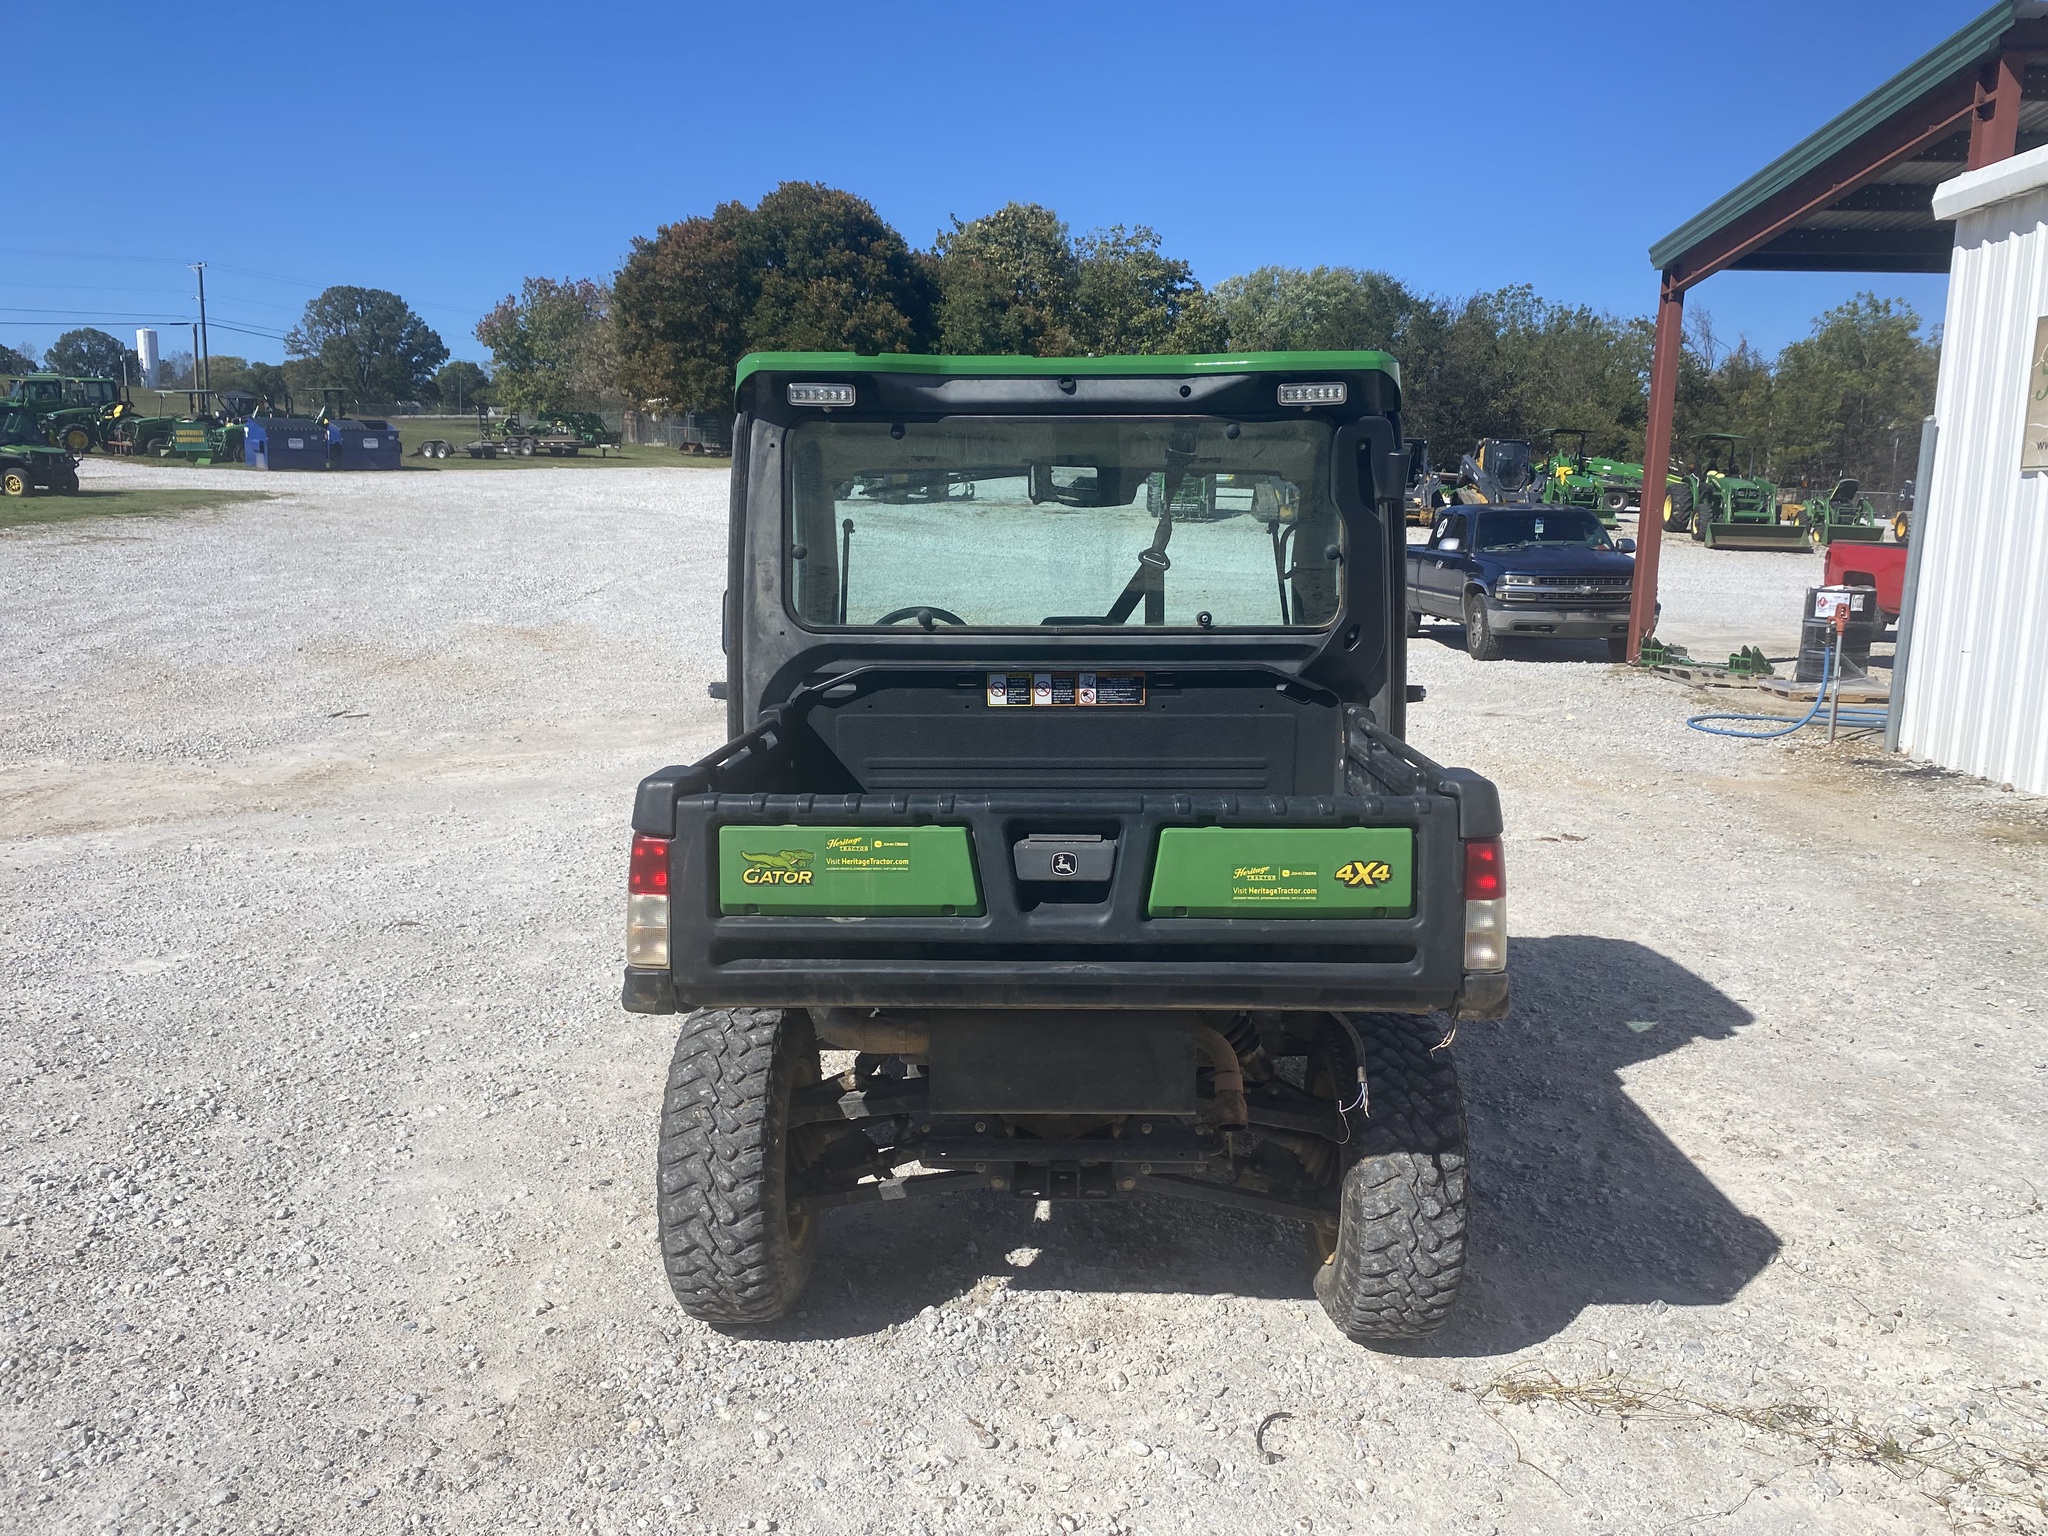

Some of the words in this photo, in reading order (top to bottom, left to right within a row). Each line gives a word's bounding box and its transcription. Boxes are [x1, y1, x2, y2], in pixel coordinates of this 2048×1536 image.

[826, 837, 862, 849] Heritage
[826, 857, 841, 865] Visit
[841, 857, 909, 867] HeritageTractor.com
[742, 868, 814, 886] GATOR
[1233, 866, 1270, 879] Heritage
[1335, 861, 1391, 885] 4X4
[1233, 886, 1247, 894] Visit
[1248, 886, 1317, 896] HeritageTractor.com
